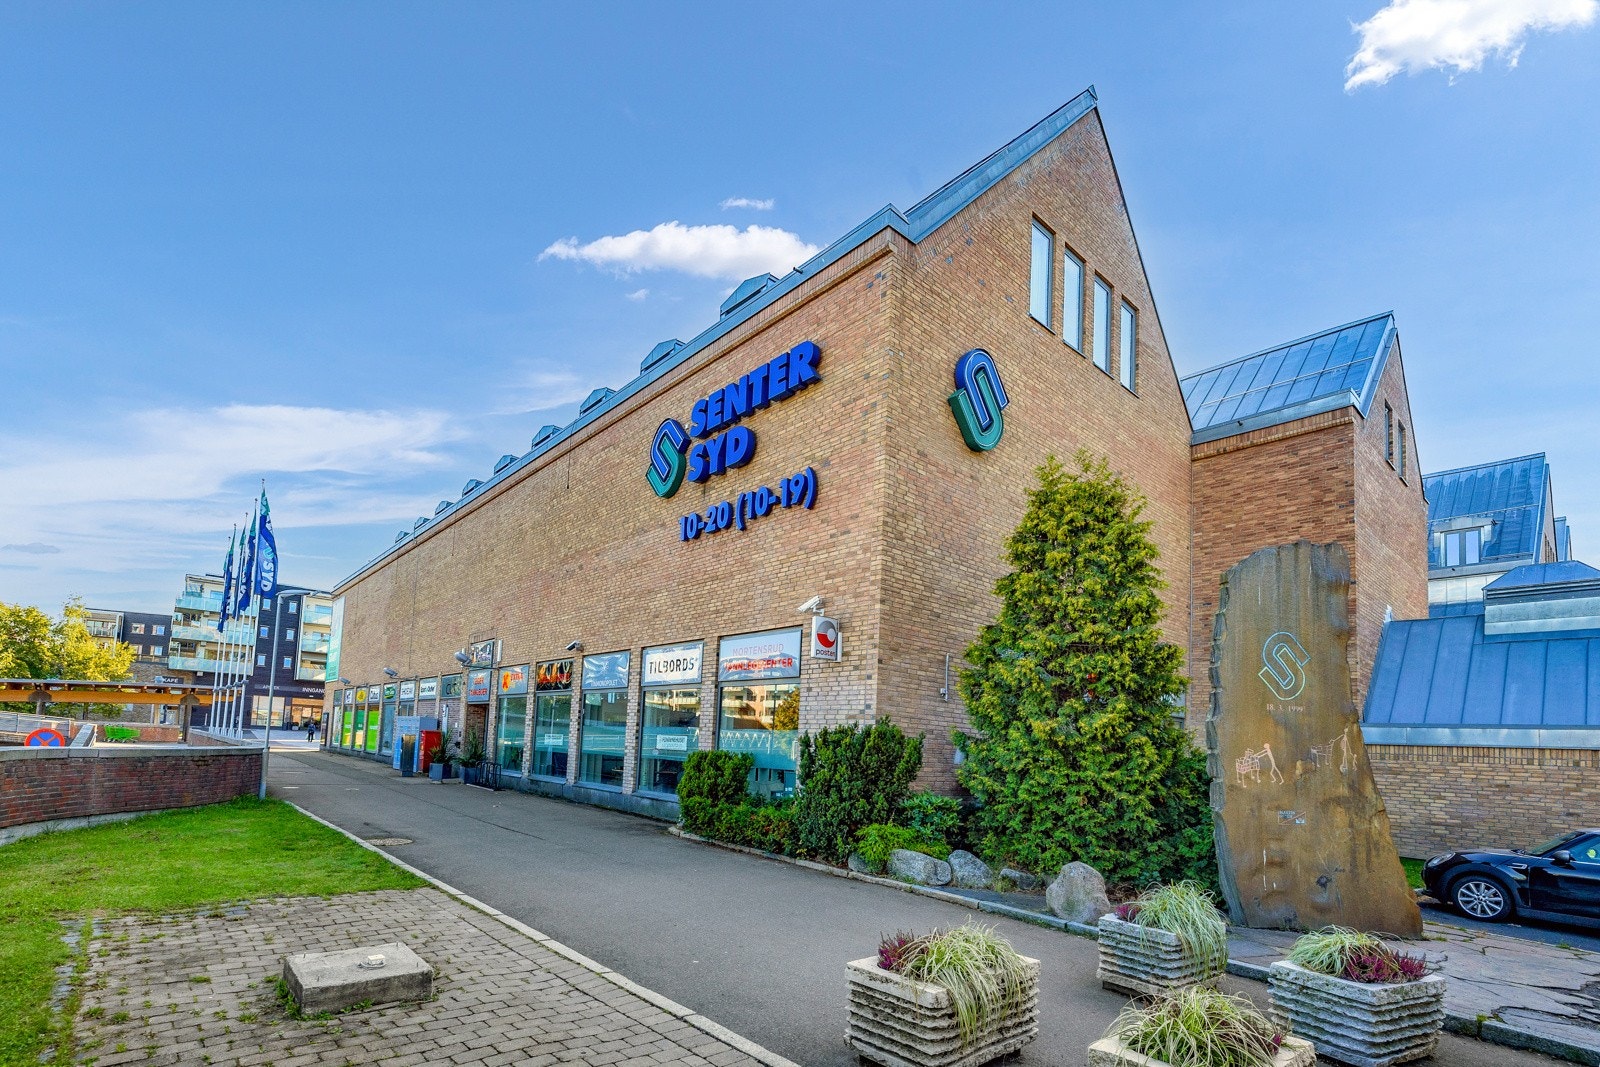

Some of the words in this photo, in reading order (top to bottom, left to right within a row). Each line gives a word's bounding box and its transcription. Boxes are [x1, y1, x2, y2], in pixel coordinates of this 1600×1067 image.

[689, 340, 821, 439] SENTER
[687, 425, 755, 483] SYD
[678, 501, 733, 541] 10-20
[735, 466, 818, 530] (10-19)
[732, 643, 784, 656] MORTENSRUD
